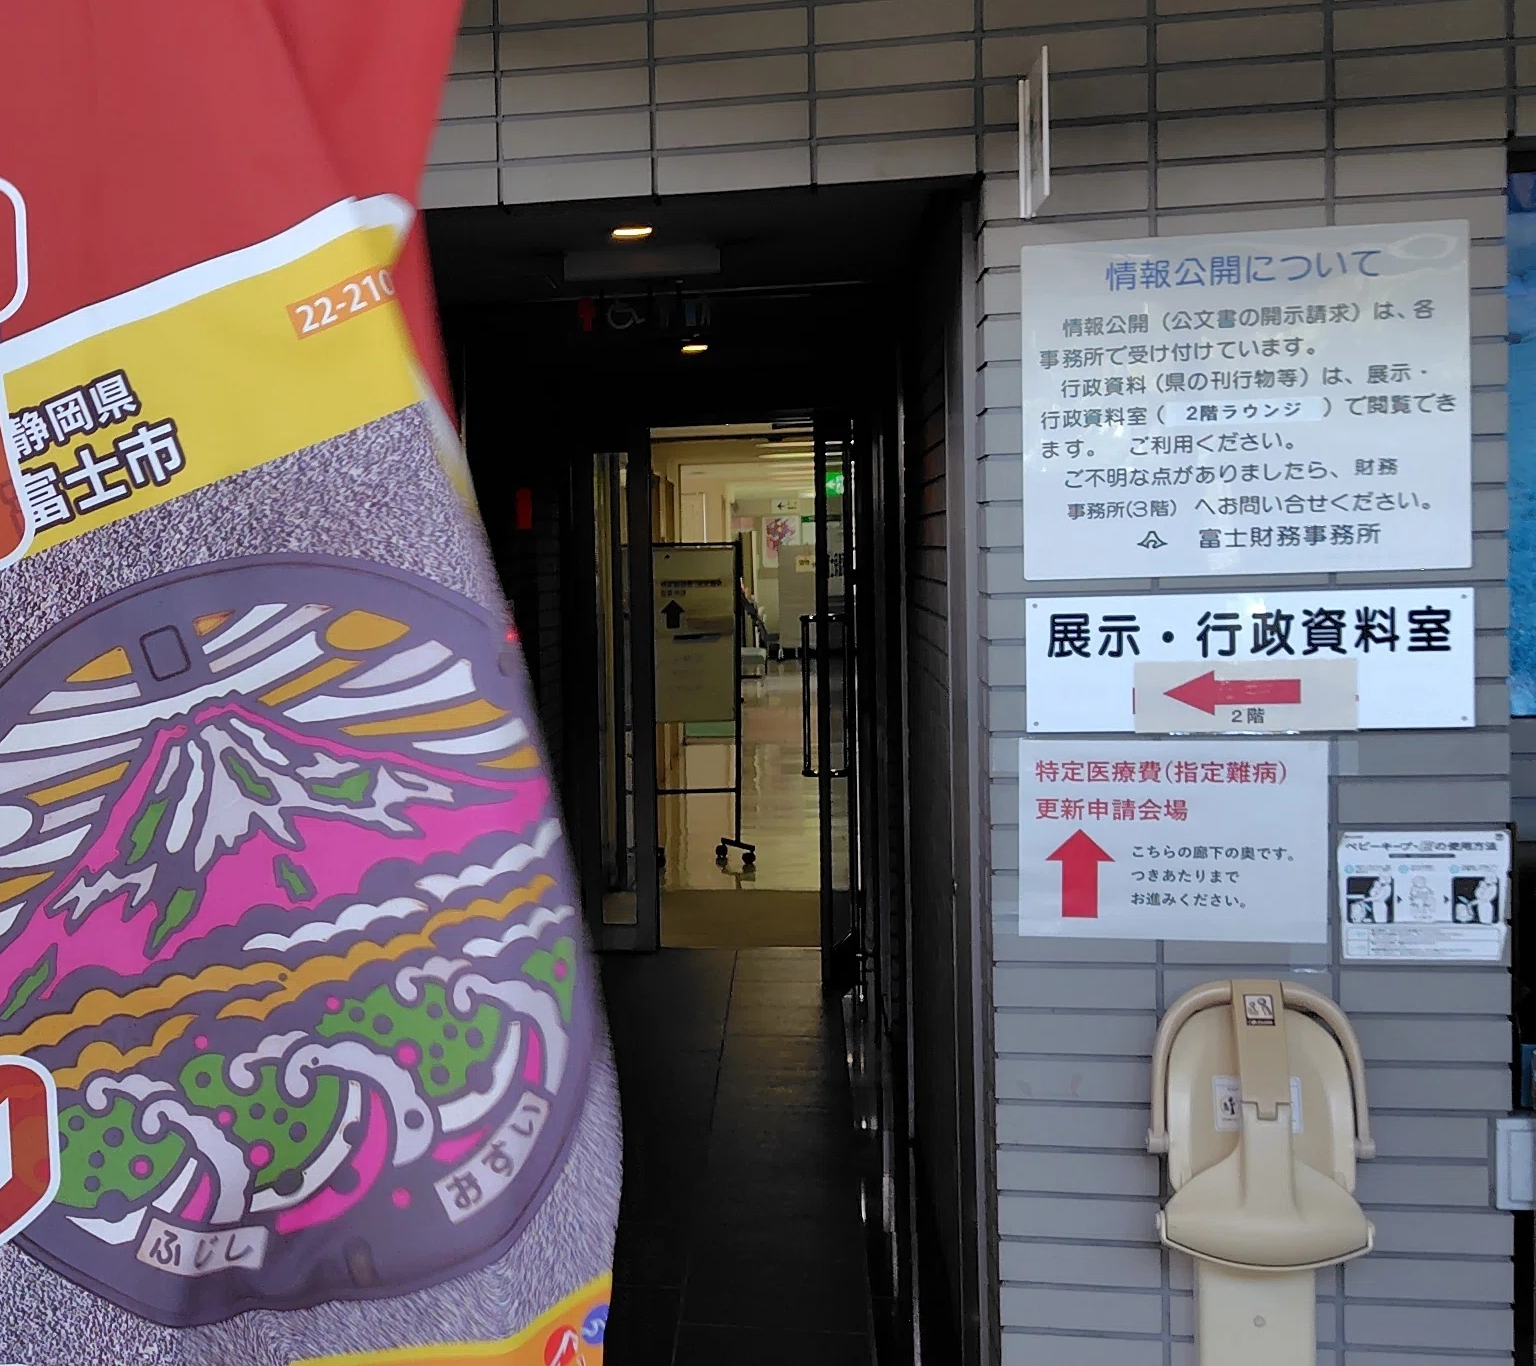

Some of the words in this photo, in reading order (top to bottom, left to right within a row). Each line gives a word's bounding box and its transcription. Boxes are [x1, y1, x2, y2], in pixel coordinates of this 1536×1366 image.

[1105, 248, 1382, 292] 情報公開について
[1061, 298, 1436, 338] 情報公開（公文書の開示請求）は、各
[1038, 336, 1317, 370] 事務所で受け付けています。
[1060, 364, 1430, 398] 行政資料（県の刊行物等）は、展示・
[7, 371, 139, 459] 静岡県
[20, 420, 185, 530] 富士市
[1198, 522, 1382, 550] 富士財務事務所
[1046, 605, 1453, 659] 展示・行政資料室
[1230, 707, 1266, 725] 2階
[1034, 797, 1189, 822] 更新申請会場
[1131, 845, 1295, 862] こちらの廊下の奥です。
[1130, 868, 1240, 884] つきあたりまで
[1130, 892, 1247, 909] お進みください。
[445, 1101, 543, 1211] おすい
[149, 1229, 254, 1267] ふじし
